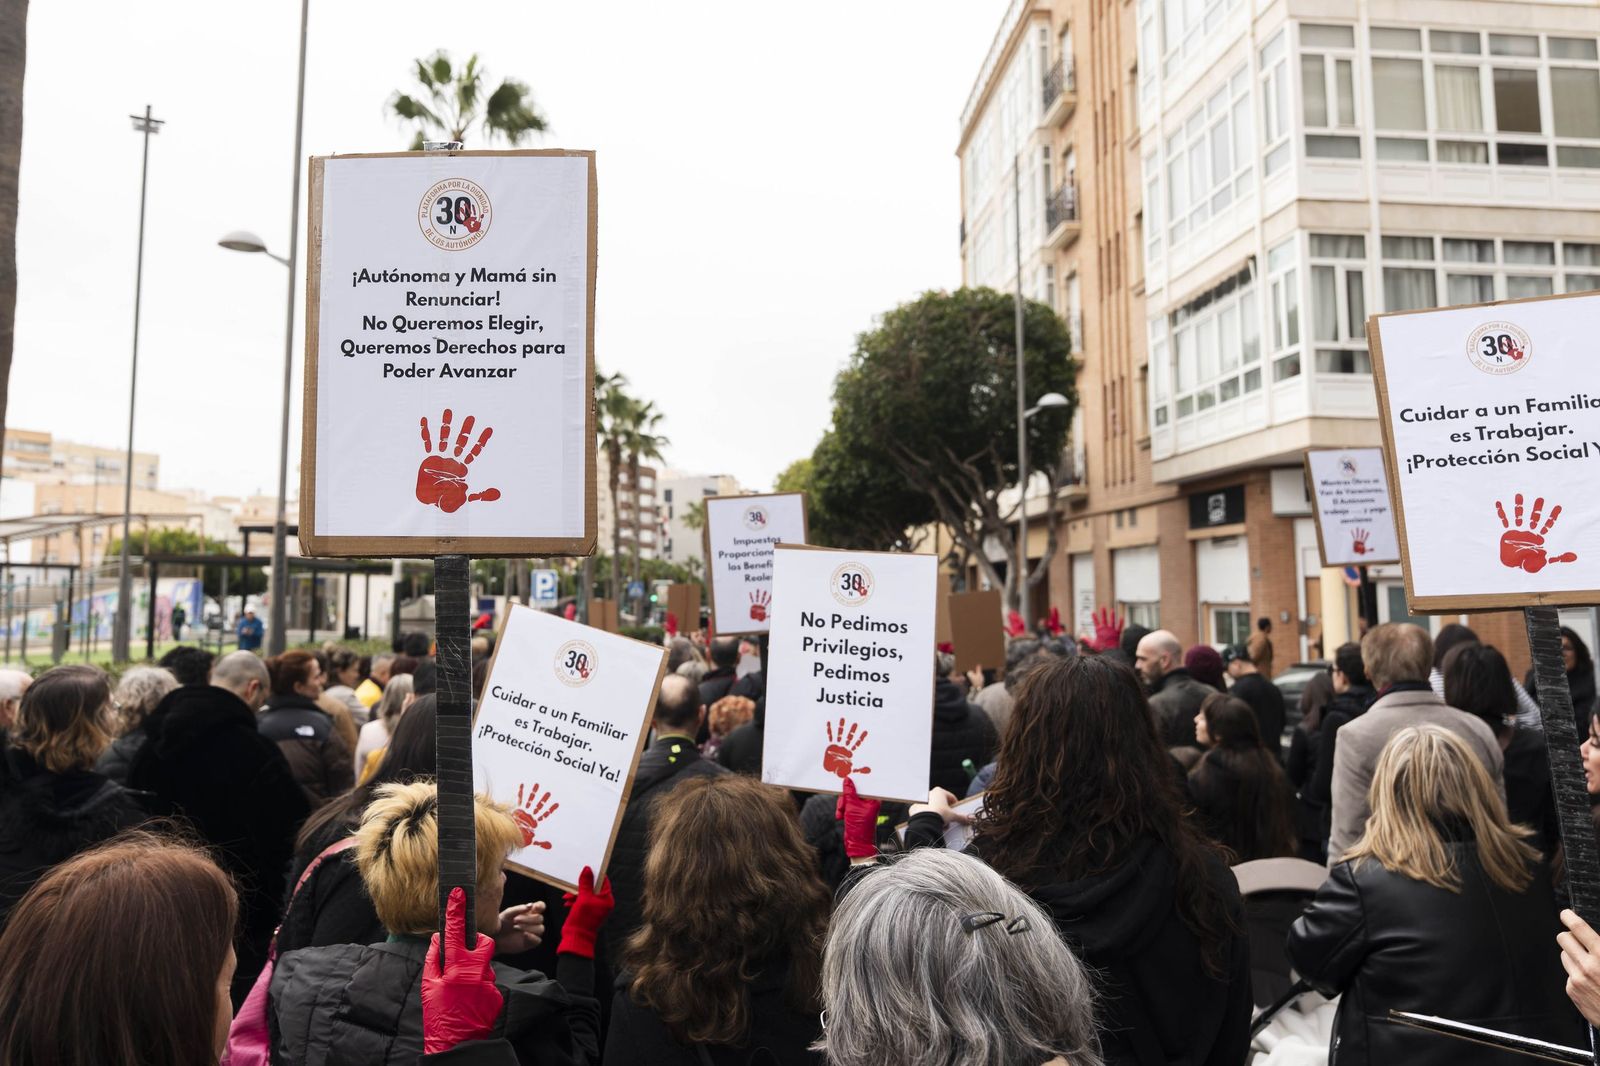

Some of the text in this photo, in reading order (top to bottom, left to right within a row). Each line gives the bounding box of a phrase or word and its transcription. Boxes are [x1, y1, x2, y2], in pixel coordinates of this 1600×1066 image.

[422, 183, 448, 218] PLATAFORMA
[462, 182, 470, 190] LA
[470, 186, 489, 214] DIGNIDAD
[436, 196, 472, 225] 30
[425, 228, 433, 238] DE
[433, 236, 445, 246] LOS
[449, 225, 456, 235] N
[352, 267, 557, 288] ¡Autónoma y Mamá sin
[405, 290, 501, 307] Renunciar!
[362, 314, 544, 335] No Queremos Elegir,
[340, 338, 566, 359] Queremos Derechos para
[1481, 334, 1512, 356] 30
[383, 361, 518, 379] Poder Avanzar
[1399, 404, 1470, 424] Cuidar
[1474, 407, 1489, 418] a
[1494, 405, 1521, 416] un
[1449, 422, 1574, 443] es Trabajar.
[1406, 448, 1521, 475] ¡Protección
[1525, 441, 1590, 462] Social
[733, 536, 781, 547] Impuestos
[728, 562, 741, 571] los
[840, 572, 862, 591] 30
[800, 611, 908, 634] No Pedimos
[802, 636, 903, 662] Privilegios,
[564, 650, 588, 672] 30
[813, 661, 890, 684] Pedimos
[815, 687, 884, 709] Justicia
[491, 686, 629, 742] Cuidar a un Familiar
[514, 718, 593, 753] es Trabajar.
[478, 725, 621, 783] ¡Protección Social Ya!
